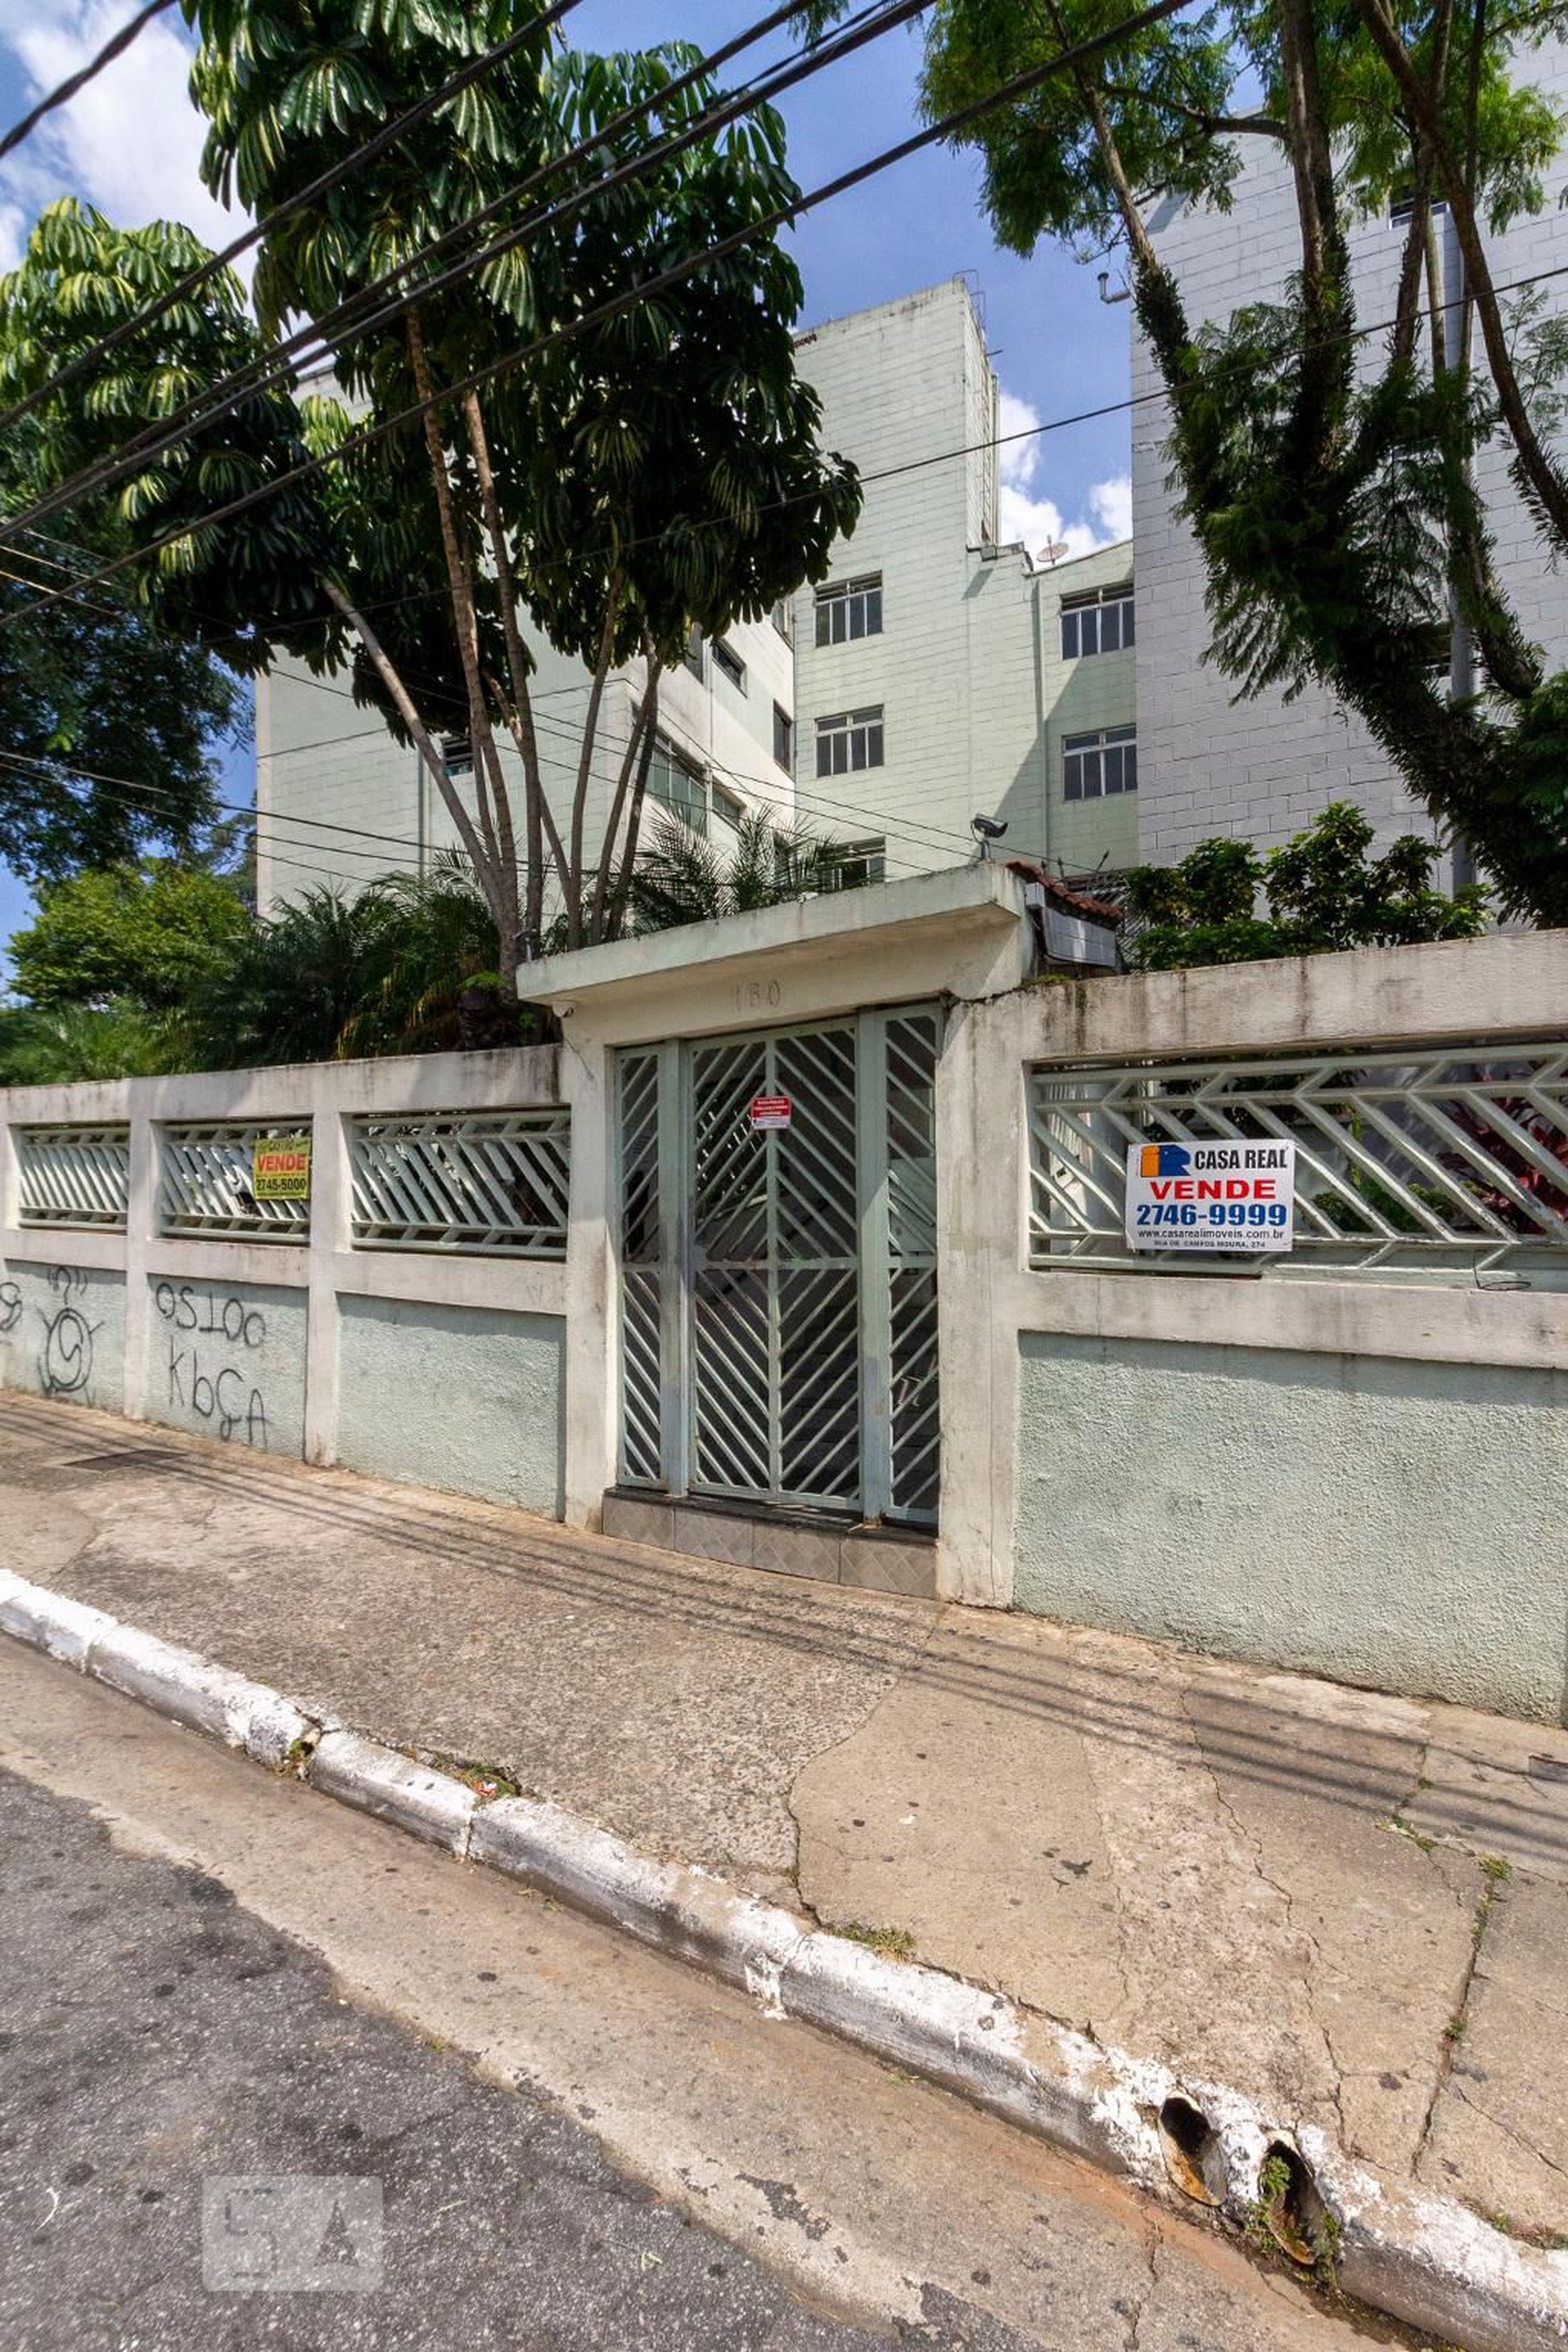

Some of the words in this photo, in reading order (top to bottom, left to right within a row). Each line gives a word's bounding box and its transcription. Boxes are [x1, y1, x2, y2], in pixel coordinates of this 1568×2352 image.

[258, 1153, 306, 1172] VENDE
[1195, 1150, 1241, 1170] CASA
[1245, 1149, 1287, 1169] REAL
[256, 1178, 307, 1190] 2745-5000
[1150, 1180, 1276, 1200] VENDE
[1137, 1203, 1287, 1226] 2746-9999
[1138, 1228, 1284, 1239] www.casarealimoveis.com.br
